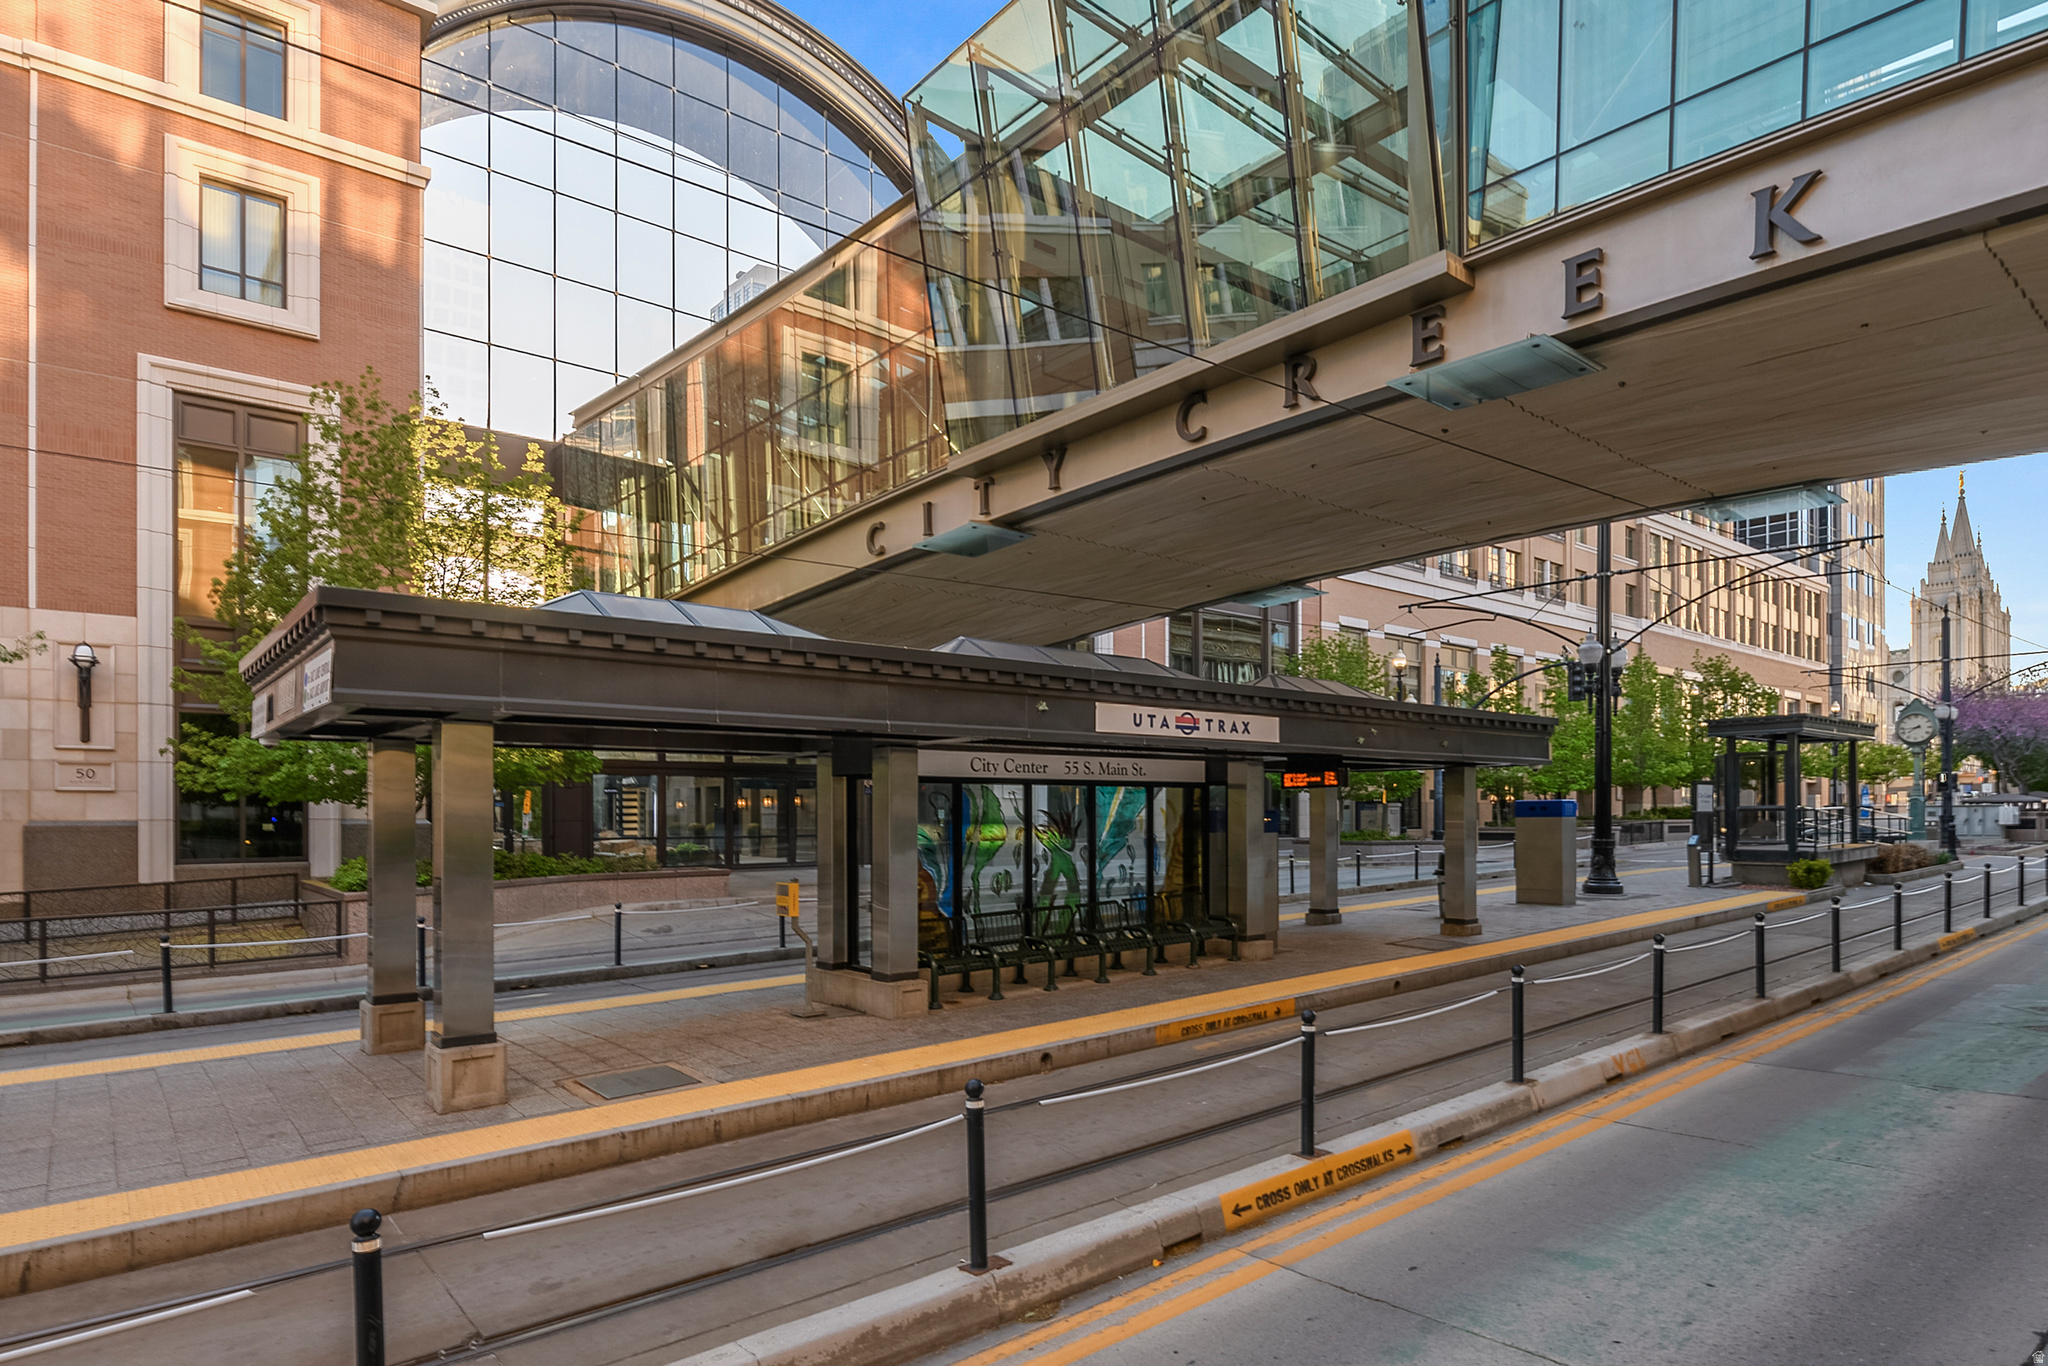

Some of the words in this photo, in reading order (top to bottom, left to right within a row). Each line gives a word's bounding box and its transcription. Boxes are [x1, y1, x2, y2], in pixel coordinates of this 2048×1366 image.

[866, 446, 1068, 556] CITY
[1175, 169, 1823, 442] CREEK
[1133, 713, 1170, 729] UTA
[1205, 719, 1251, 734] TRAX
[76, 768, 95, 779] 50
[970, 756, 999, 775] City
[1003, 757, 1049, 774] Center
[1064, 760, 1079, 775] 55
[1083, 760, 1095, 776] S.
[1098, 761, 1128, 776] Main
[1131, 761, 1147, 777] St.
[1255, 1186, 1292, 1210] CROSS
[1294, 1176, 1320, 1197] ONLY
[1322, 1170, 1334, 1187] AT
[1336, 1149, 1395, 1182] CROSSWALKS
